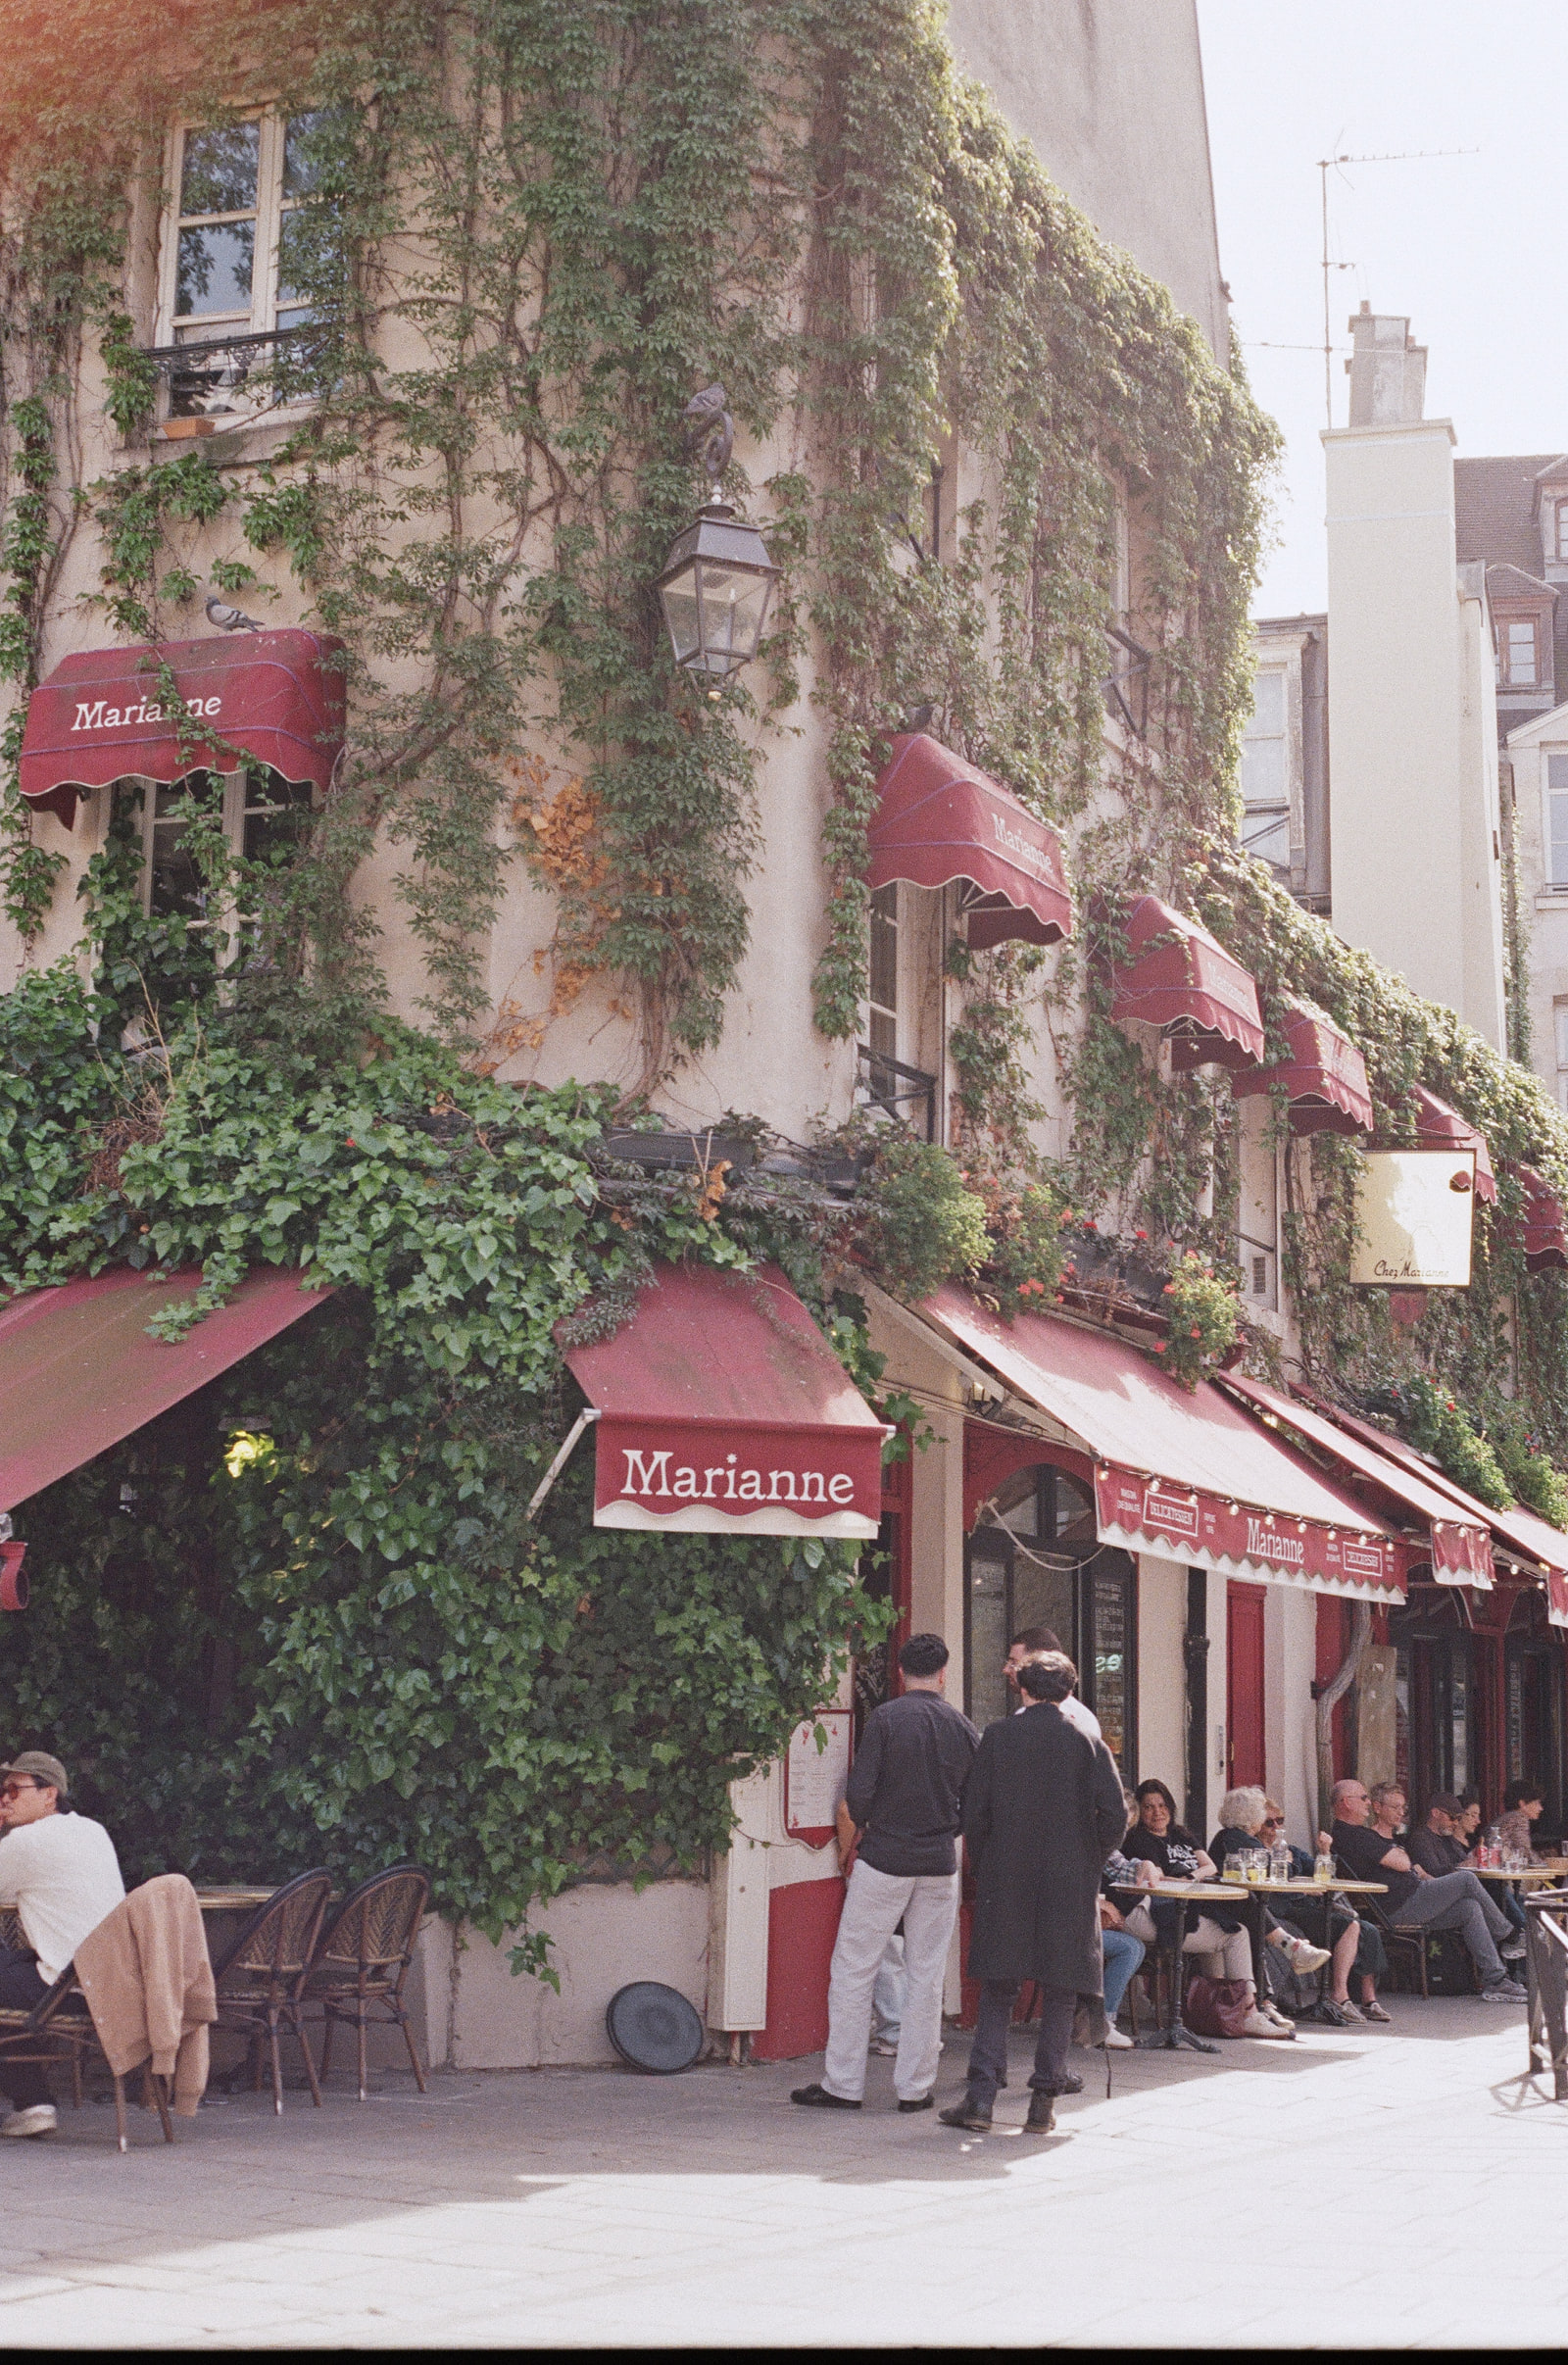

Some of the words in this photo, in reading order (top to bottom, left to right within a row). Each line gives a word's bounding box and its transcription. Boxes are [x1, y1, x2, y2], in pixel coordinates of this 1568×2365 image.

[991, 813, 1054, 873] Marianne
[1374, 1259, 1398, 1279] Chez
[620, 1449, 855, 1504] Marianne
[1246, 1516, 1305, 1565] Marianne
